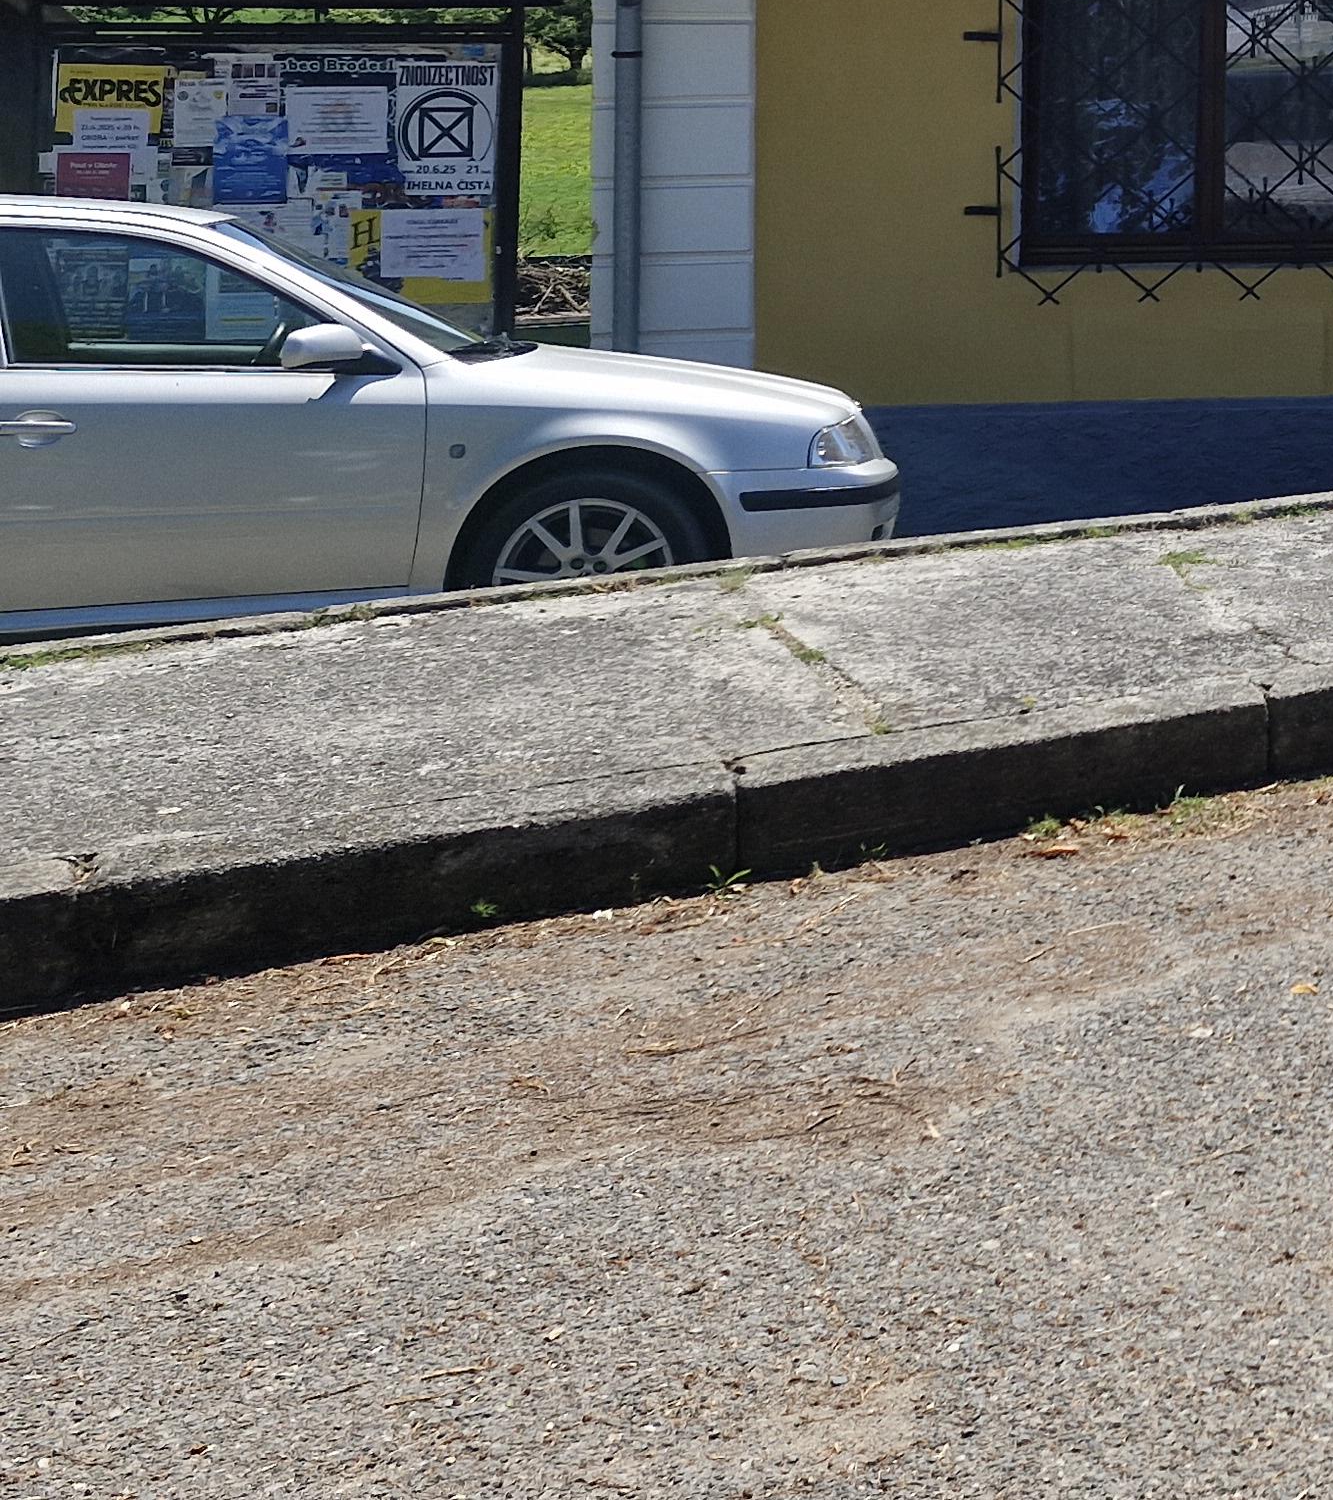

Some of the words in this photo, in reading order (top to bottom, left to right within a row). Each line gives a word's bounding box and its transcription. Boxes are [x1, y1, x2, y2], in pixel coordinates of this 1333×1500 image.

[326, 57, 396, 72] Brodesl
[398, 65, 496, 86] ZNOUZECTNOST
[60, 78, 162, 107] EXPRES
[416, 164, 456, 175] 20.6.25
[466, 164, 480, 174] 21
[407, 180, 453, 191] IHELNA
[350, 216, 380, 250] H
